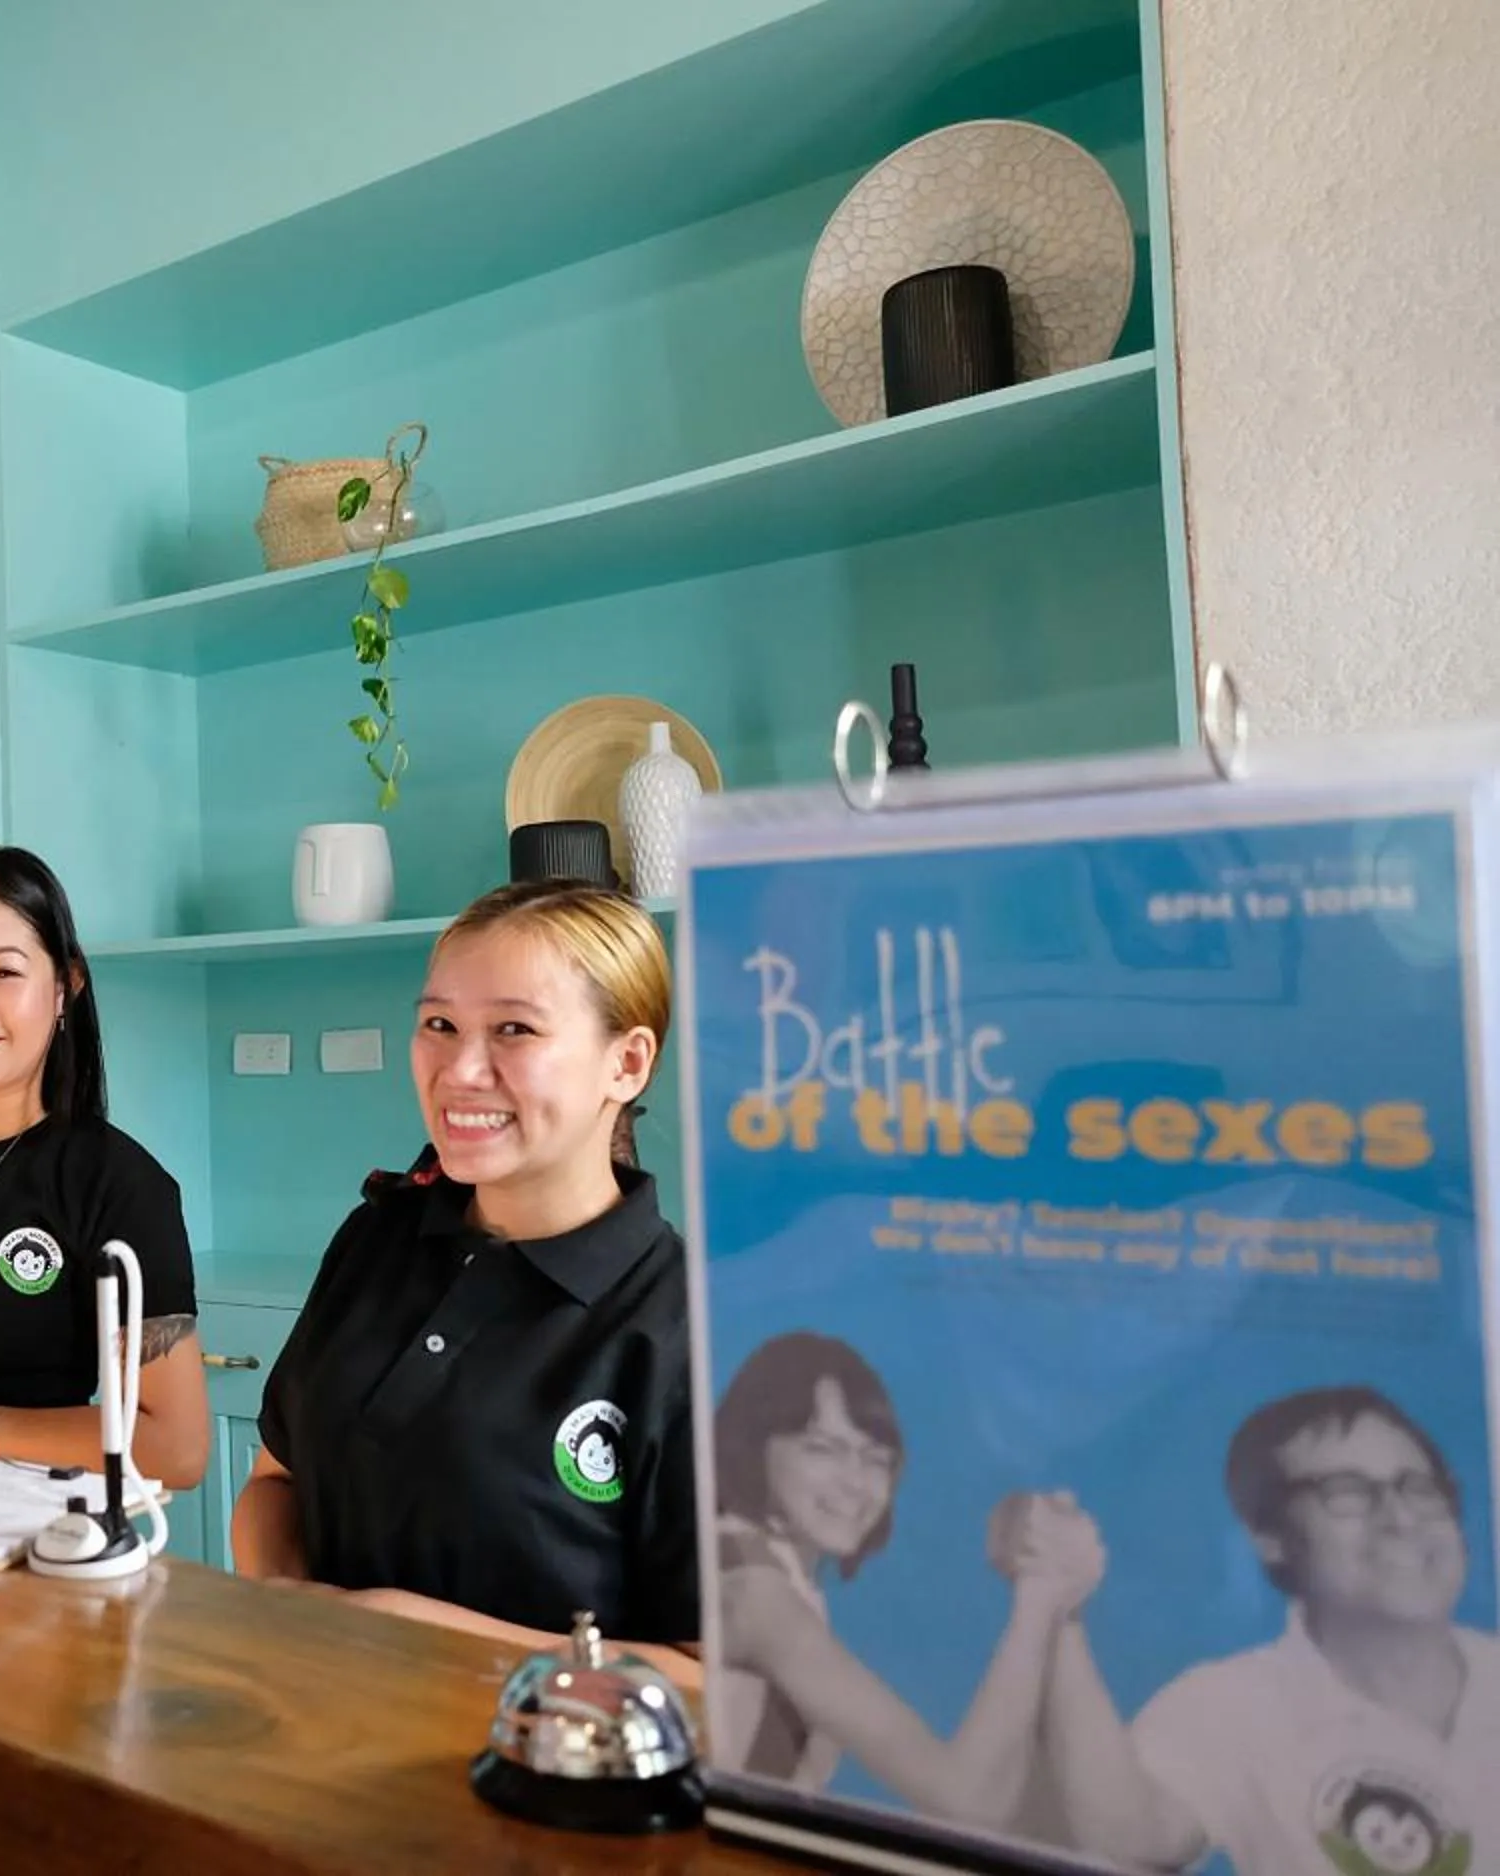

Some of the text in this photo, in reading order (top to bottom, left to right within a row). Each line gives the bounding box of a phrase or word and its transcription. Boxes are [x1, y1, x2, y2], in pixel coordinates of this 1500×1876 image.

[1245, 891, 1289, 920] to
[744, 926, 1016, 1123] Battle
[728, 1081, 1434, 1171] of the sexes
